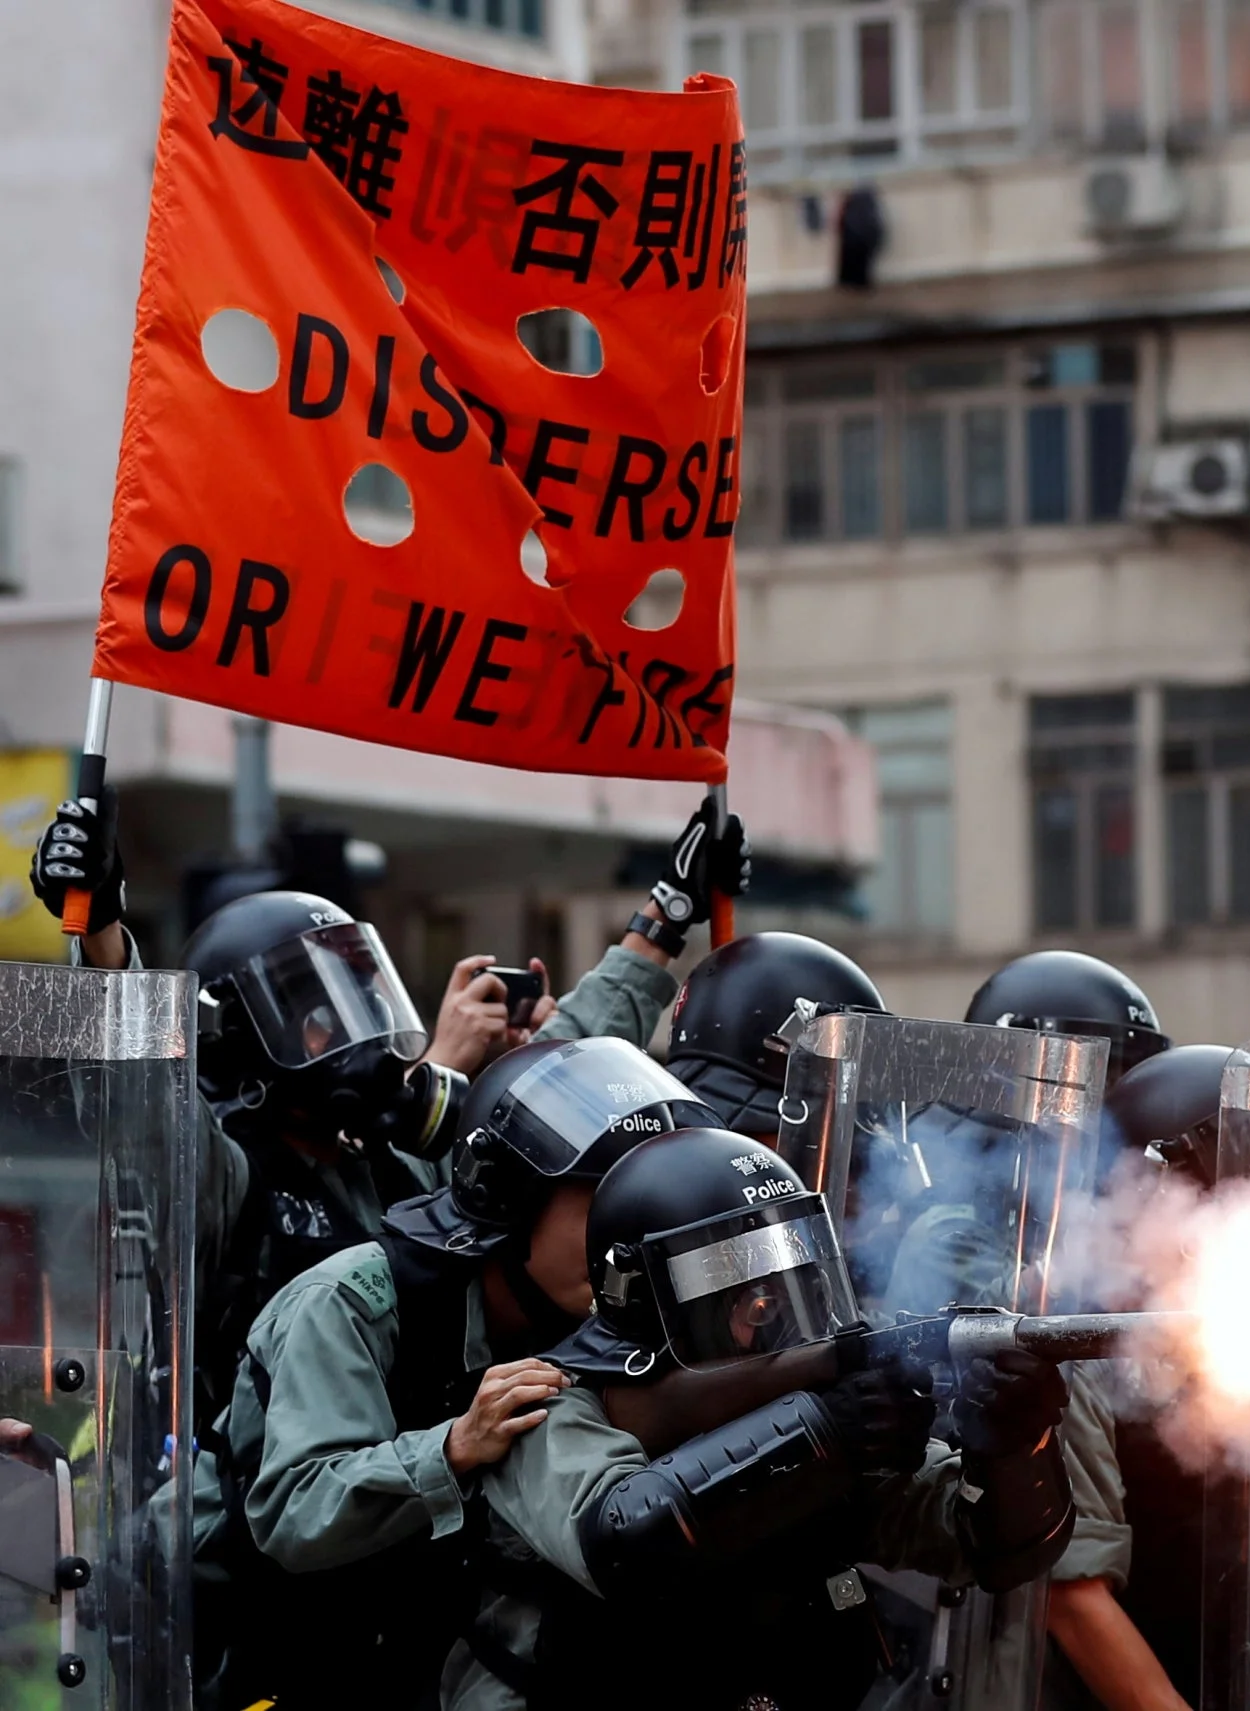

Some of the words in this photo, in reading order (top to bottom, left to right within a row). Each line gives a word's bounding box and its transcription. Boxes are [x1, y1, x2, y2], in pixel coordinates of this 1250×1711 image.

[144, 543, 290, 677] OR
[388, 600, 529, 727] WE
[607, 1112, 662, 1133] Police
[730, 1152, 775, 1176] 警察
[742, 1178, 796, 1205] Police
